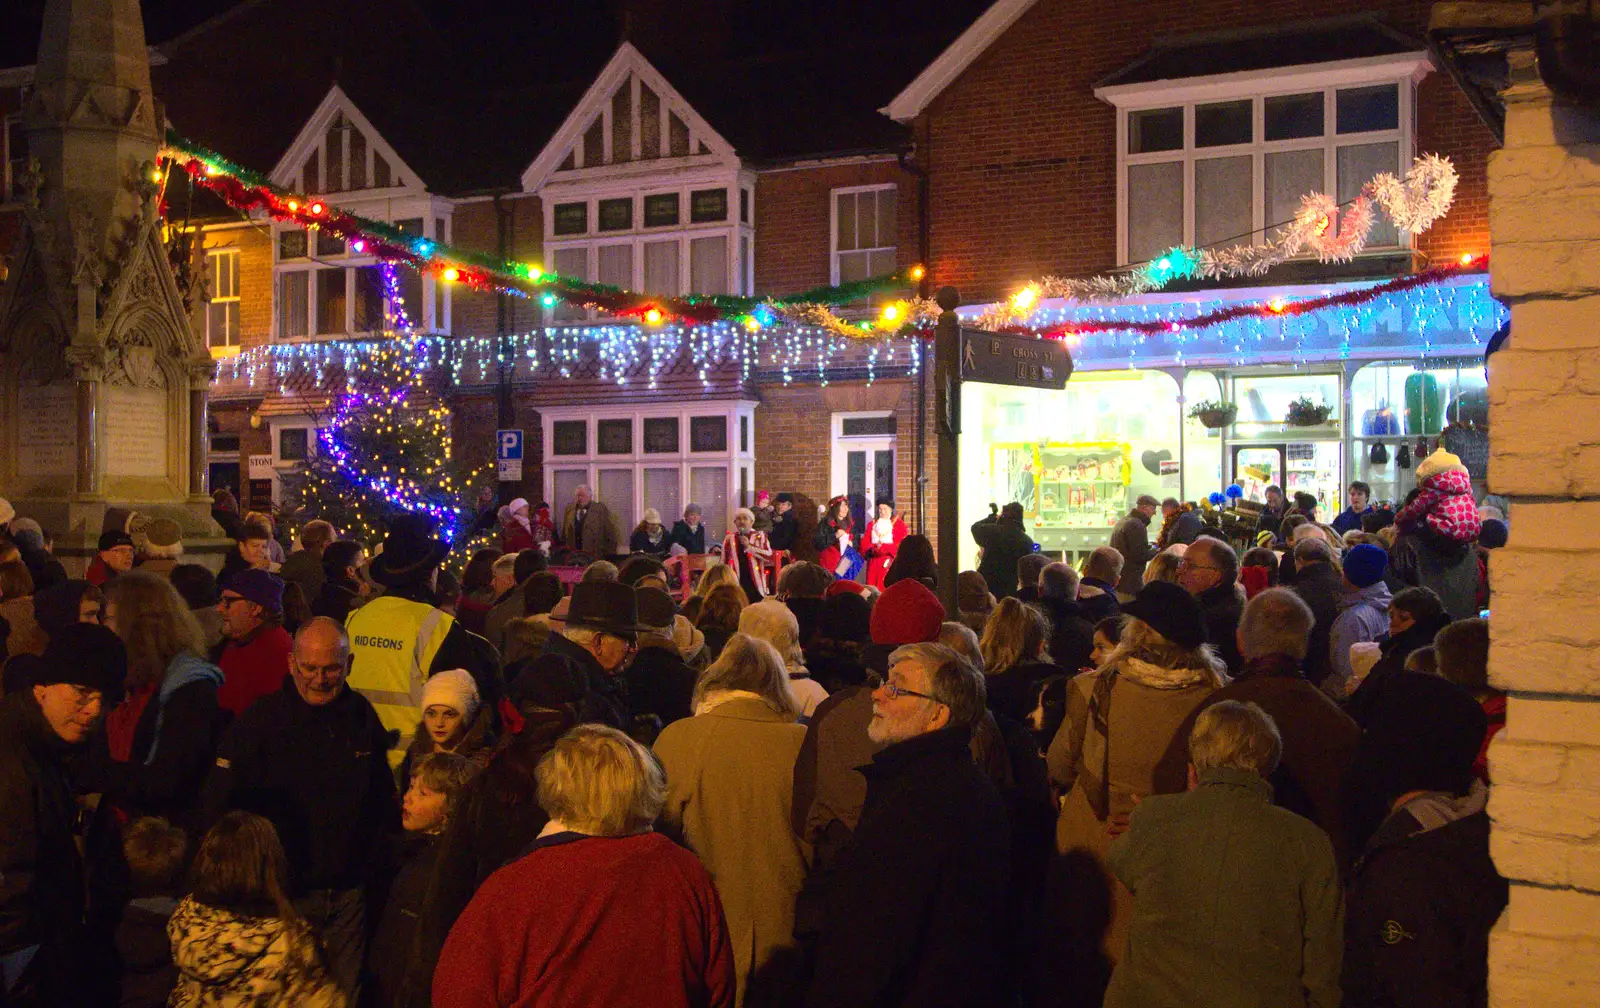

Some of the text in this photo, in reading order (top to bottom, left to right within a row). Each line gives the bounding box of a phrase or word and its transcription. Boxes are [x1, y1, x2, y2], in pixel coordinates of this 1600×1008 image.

[1013, 347, 1039, 360] CROSS
[502, 432, 518, 458] P
[354, 635, 404, 651] RIDGEONS
